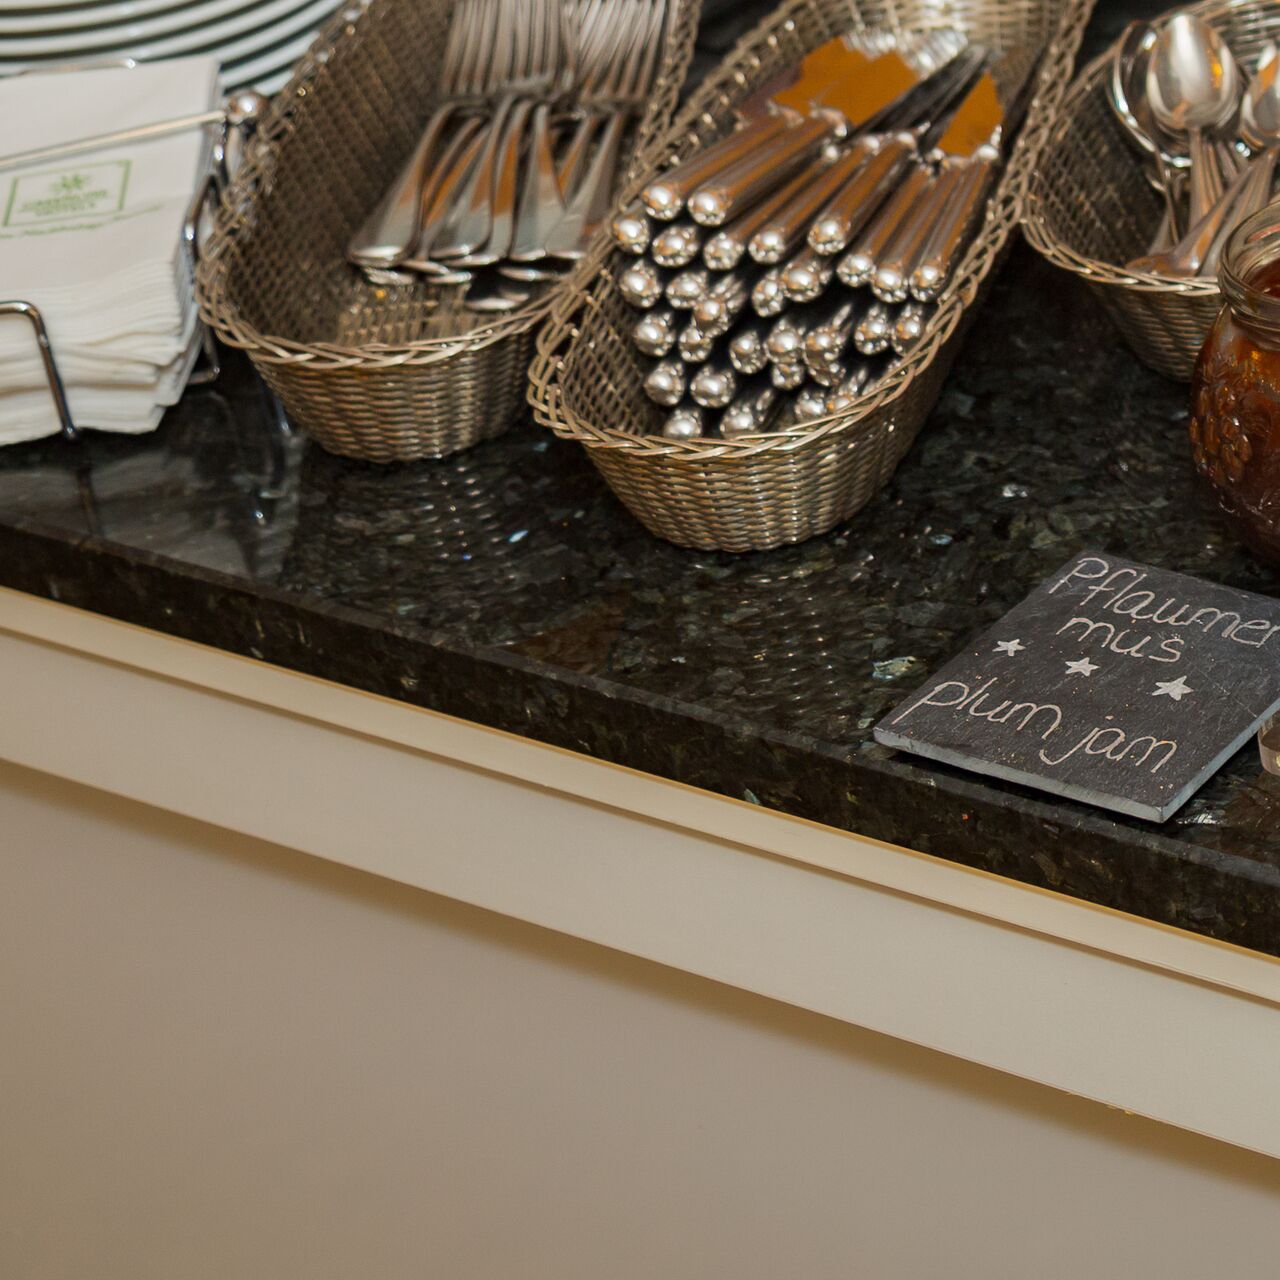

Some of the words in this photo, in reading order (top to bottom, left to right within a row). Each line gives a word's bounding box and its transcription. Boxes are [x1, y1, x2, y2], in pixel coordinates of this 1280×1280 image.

[1056, 617, 1185, 663] mus
[892, 677, 1063, 739] plum
[1039, 714, 1178, 775] jam
